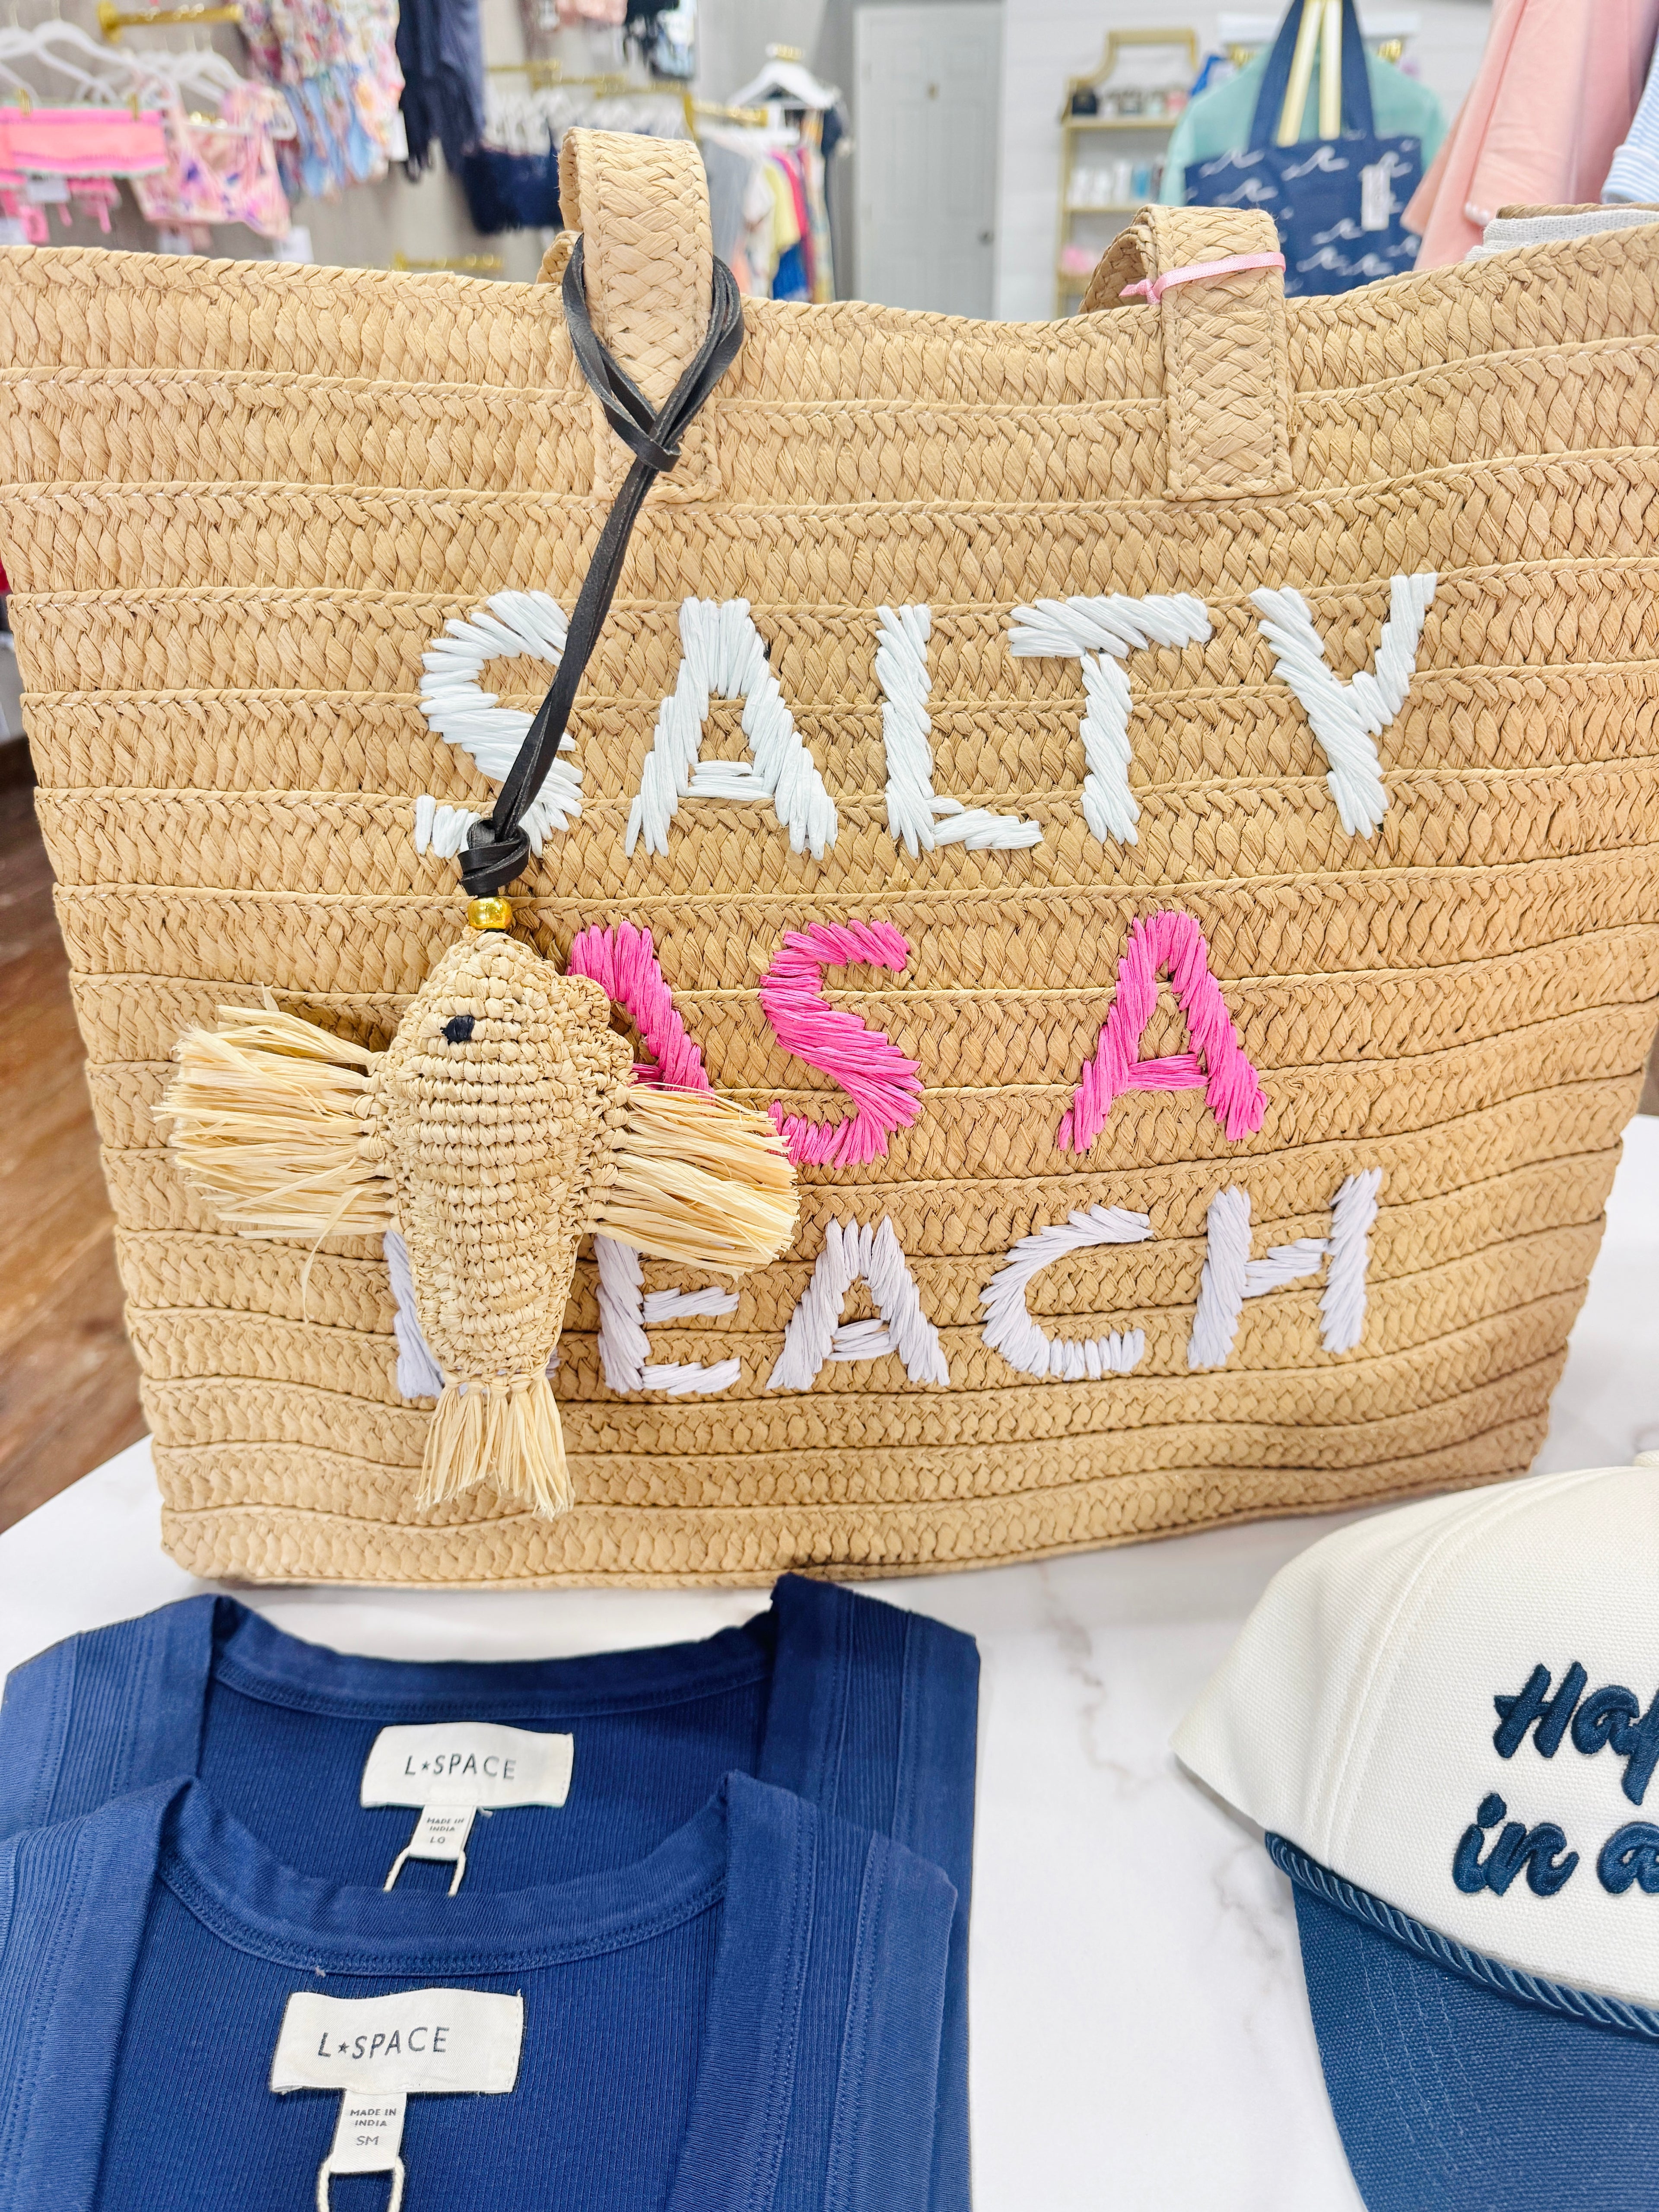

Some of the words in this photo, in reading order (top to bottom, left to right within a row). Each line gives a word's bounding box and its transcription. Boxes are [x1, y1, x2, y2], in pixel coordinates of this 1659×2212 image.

[416, 572, 1438, 860] SALTY
[383, 1168, 1382, 1399] EACH
[430, 1836, 446, 1844] LO
[1452, 1792, 1580, 1897] in
[385, 2108, 397, 2116] IN
[356, 2136, 379, 2146] SM
